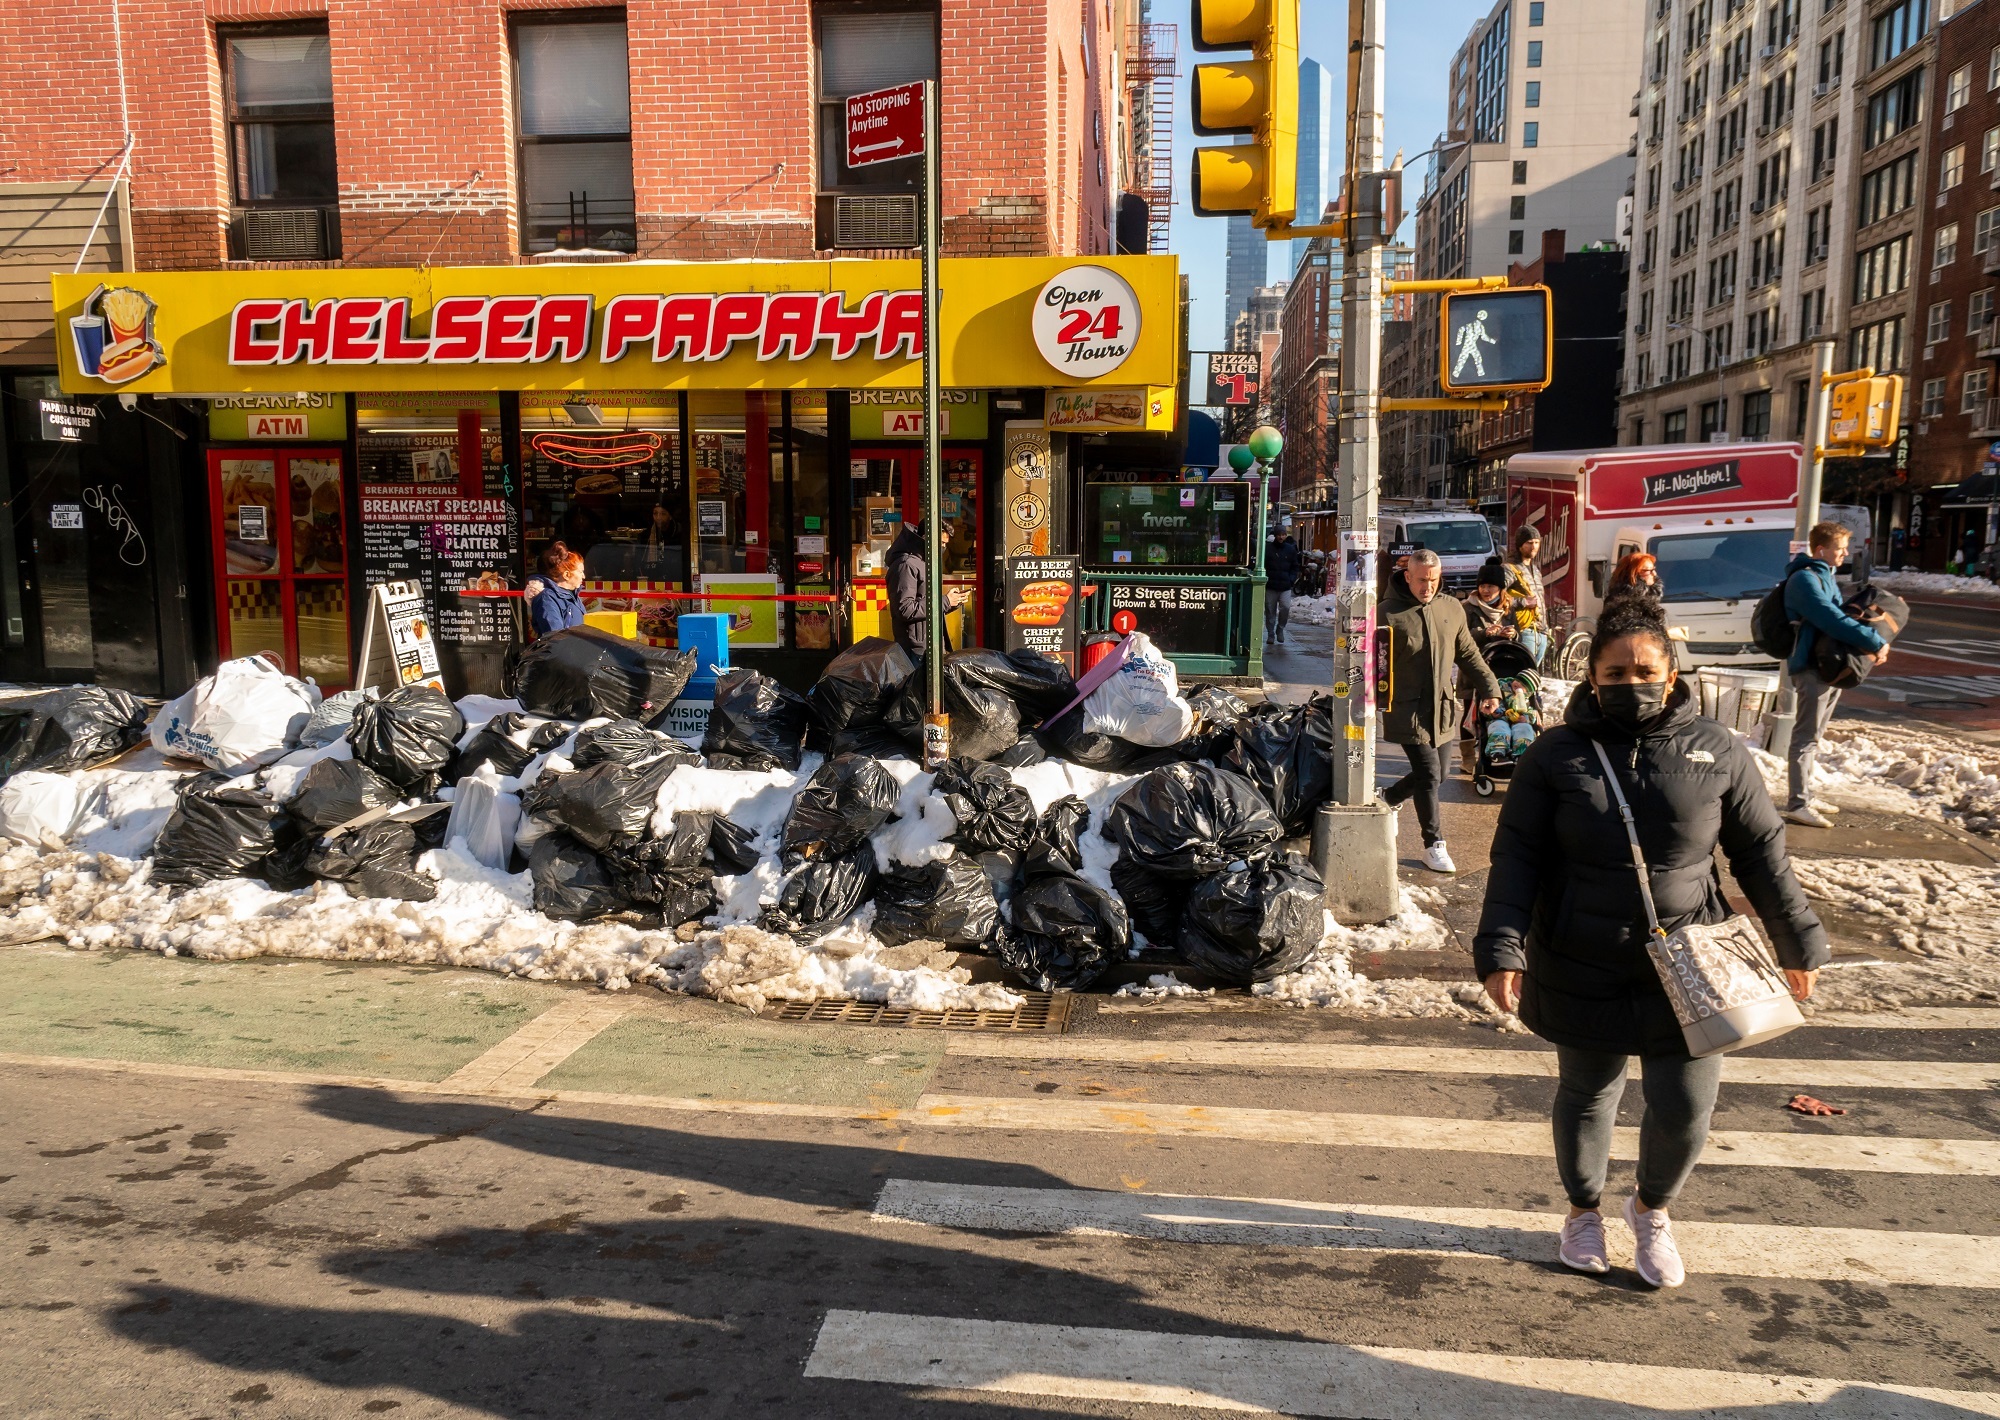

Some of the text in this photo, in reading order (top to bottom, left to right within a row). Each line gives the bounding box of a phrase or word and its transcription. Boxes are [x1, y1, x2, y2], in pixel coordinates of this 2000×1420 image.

[851, 92, 910, 117] NO STOPPING
[851, 115, 888, 133] Anytime
[1045, 285, 1103, 313] Open
[228, 289, 943, 366] CHELSEA PAPAYA
[1057, 305, 1123, 344] 24
[1064, 342, 1128, 363] Hours
[1211, 354, 1258, 364] PIZZA
[1211, 363, 1258, 374] SLICE
[625, 397, 648, 405] PINA
[793, 395, 811, 405] GO
[849, 390, 979, 404] BREAKAST
[1056, 395, 1093, 412] The Best
[41, 401, 97, 417] PAPAYA & PIZZA
[357, 400, 378, 408] PINA
[381, 400, 419, 408] COLADA
[49, 414, 91, 428] CUSTOMERS
[1049, 411, 1074, 426] Cheese
[62, 426, 80, 437] ONLY
[256, 418, 303, 435] ATM
[1007, 432, 1046, 444] THE BEST
[1014, 443, 1038, 454] COFFEE
[1897, 429, 1909, 469] PARK
[1653, 464, 1731, 496] Hi-Neighbor!
[365, 486, 458, 495] BREAKFAST SPECIALS
[363, 500, 506, 513] BREAKFAST SPECIALS
[1016, 495, 1038, 505] COFFEE
[55, 512, 70, 520] WET
[1019, 504, 1034, 519] $1
[1909, 495, 1923, 537] PARK
[435, 524, 507, 536] BREAKFAST
[446, 538, 499, 550] PLATTER
[1017, 561, 1071, 570] ALL BEEF
[1014, 570, 1073, 579] HOT DOGS
[1113, 587, 1226, 601] 23 Street Station
[387, 599, 425, 614] BREAKFAST
[1112, 599, 1206, 610] Uptown & The Bronx
[1120, 615, 1128, 629] 1
[1022, 628, 1064, 636] CRISPY
[1024, 637, 1052, 645] FISH
[669, 708, 711, 718] VISION
[670, 721, 709, 731] TIMES
[184, 728, 214, 744] Ready
[187, 738, 219, 755] Willing
